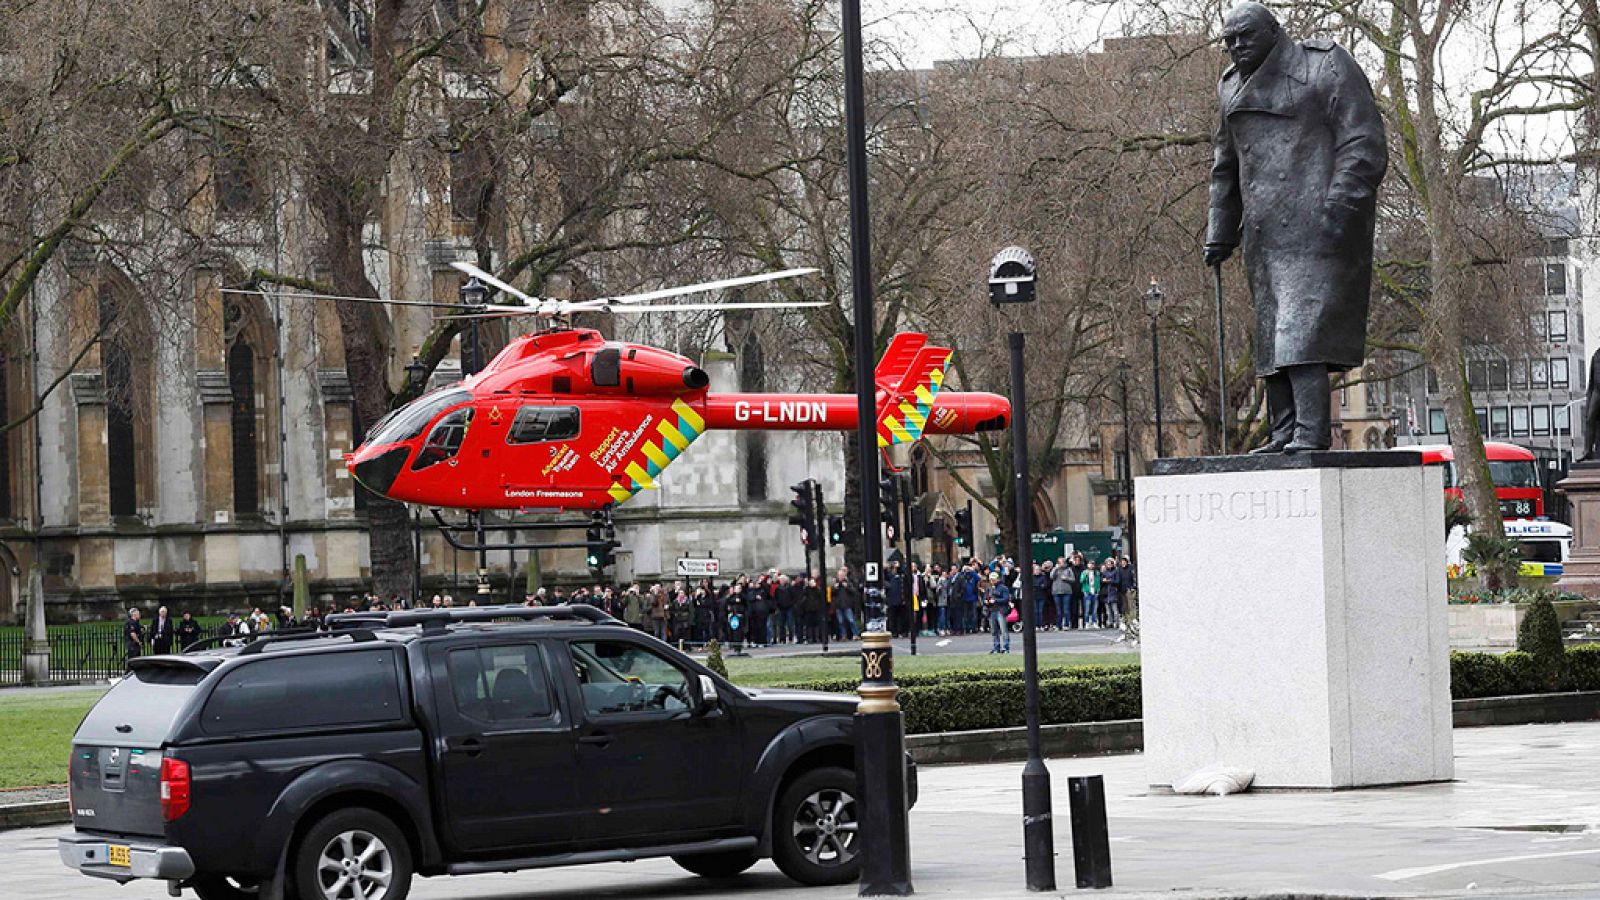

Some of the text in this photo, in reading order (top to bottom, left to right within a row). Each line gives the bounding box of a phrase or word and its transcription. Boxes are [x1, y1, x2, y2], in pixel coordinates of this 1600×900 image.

[735, 401, 827, 422] G-LNDN
[589, 427, 620, 461] Support
[596, 430, 630, 467] London's
[605, 414, 654, 474] Air Ambulance
[541, 443, 570, 476] Advanced
[552, 449, 575, 473] Trauma
[562, 454, 581, 471] Team
[505, 489, 584, 498] London Freemasons
[1143, 488, 1317, 524] CHURCHILL
[1515, 502, 1531, 514] 88
